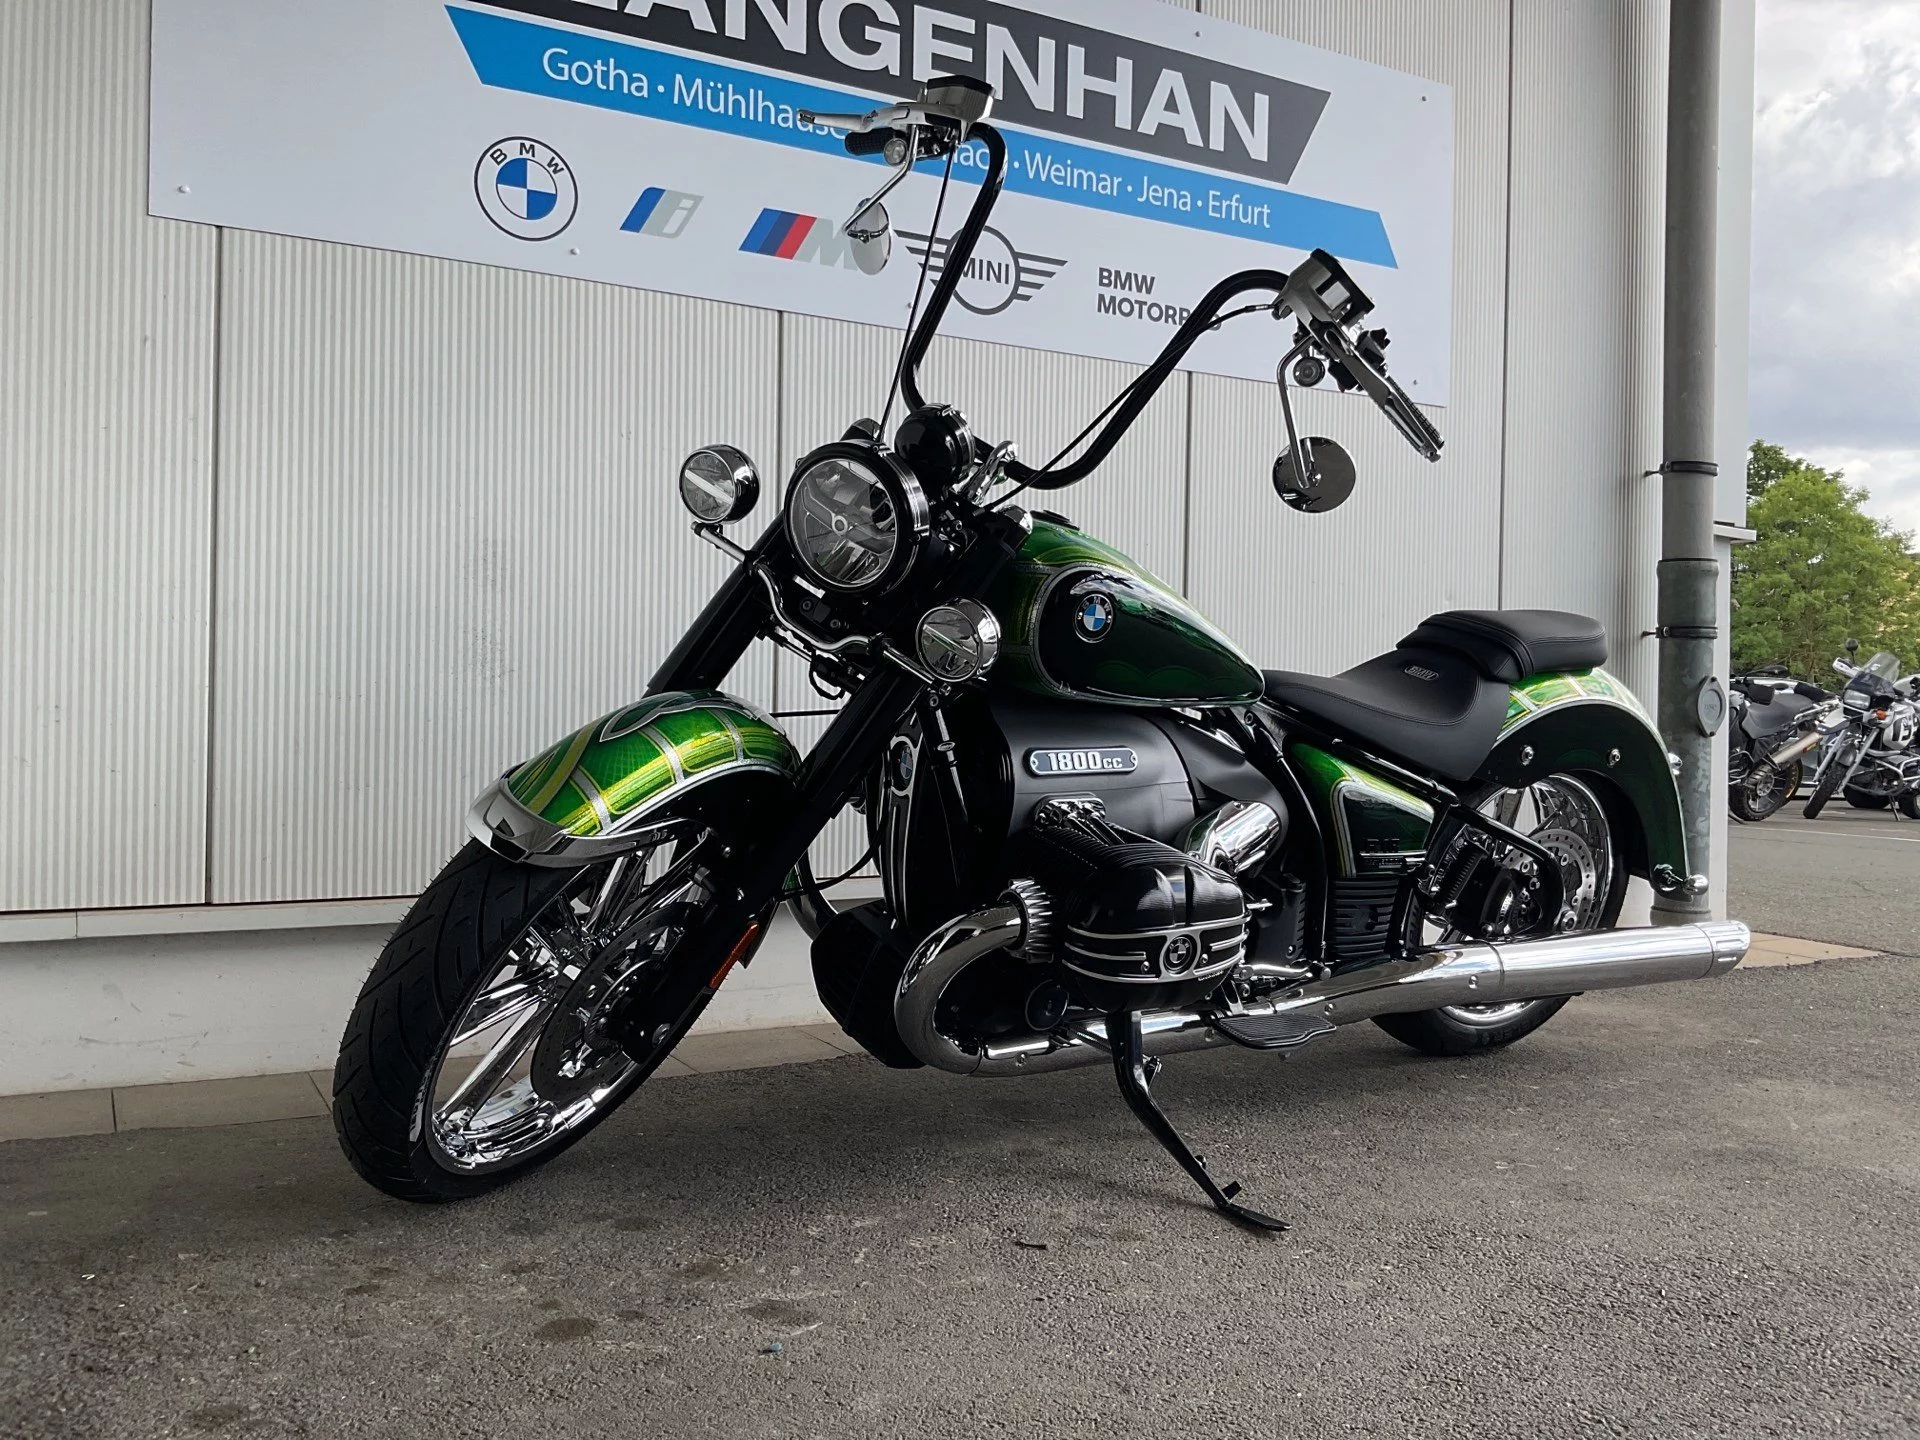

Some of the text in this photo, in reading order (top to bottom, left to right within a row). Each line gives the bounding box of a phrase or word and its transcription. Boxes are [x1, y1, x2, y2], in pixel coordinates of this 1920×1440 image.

[571, 0, 1269, 162] NGENHAN
[543, 47, 649, 98] Gotha
[1024, 149, 1121, 197] Weimar
[1137, 175, 1191, 212] Jena
[1208, 194, 1271, 229] Erfurt
[489, 142, 565, 175] BMW
[1098, 267, 1156, 295] BMW
[1097, 293, 1222, 331] MOTORR
[1047, 751, 1123, 771] 1800cc
